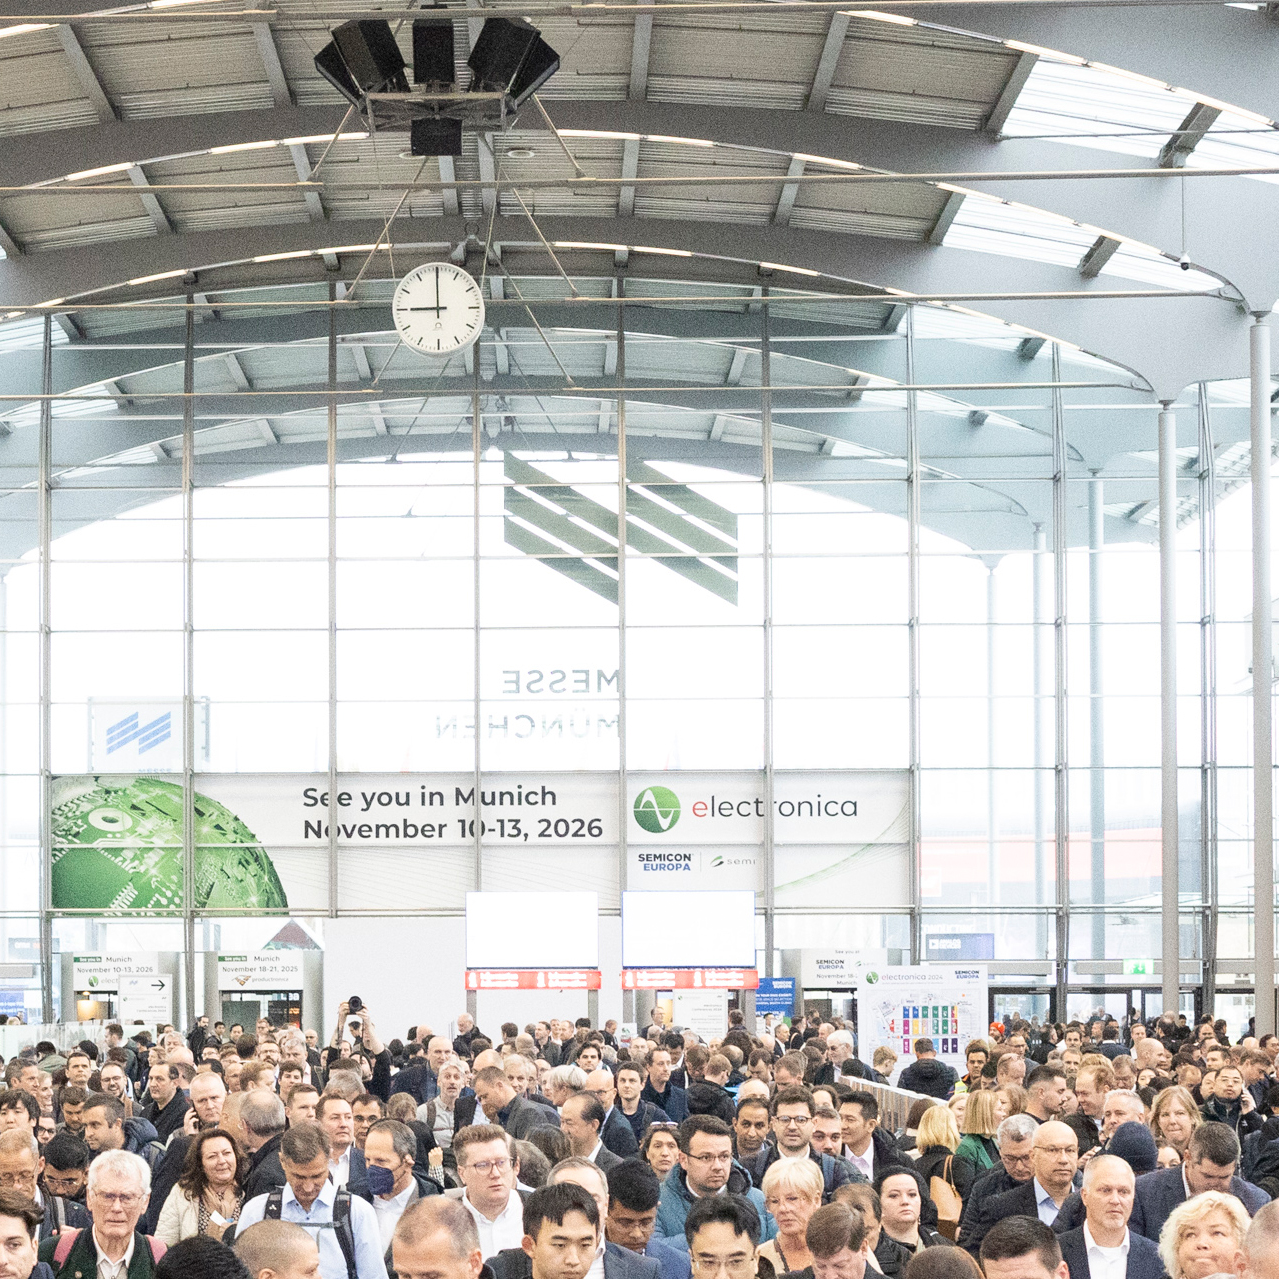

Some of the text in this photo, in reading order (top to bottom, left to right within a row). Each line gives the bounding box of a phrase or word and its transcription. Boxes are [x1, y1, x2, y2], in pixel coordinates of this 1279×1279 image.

[303, 785, 557, 812] See you in Munich
[303, 818, 603, 841] November 10-13, 2026
[638, 853, 692, 862] SEMICON
[643, 863, 691, 872] EUROPA
[881, 972, 926, 980] electronica
